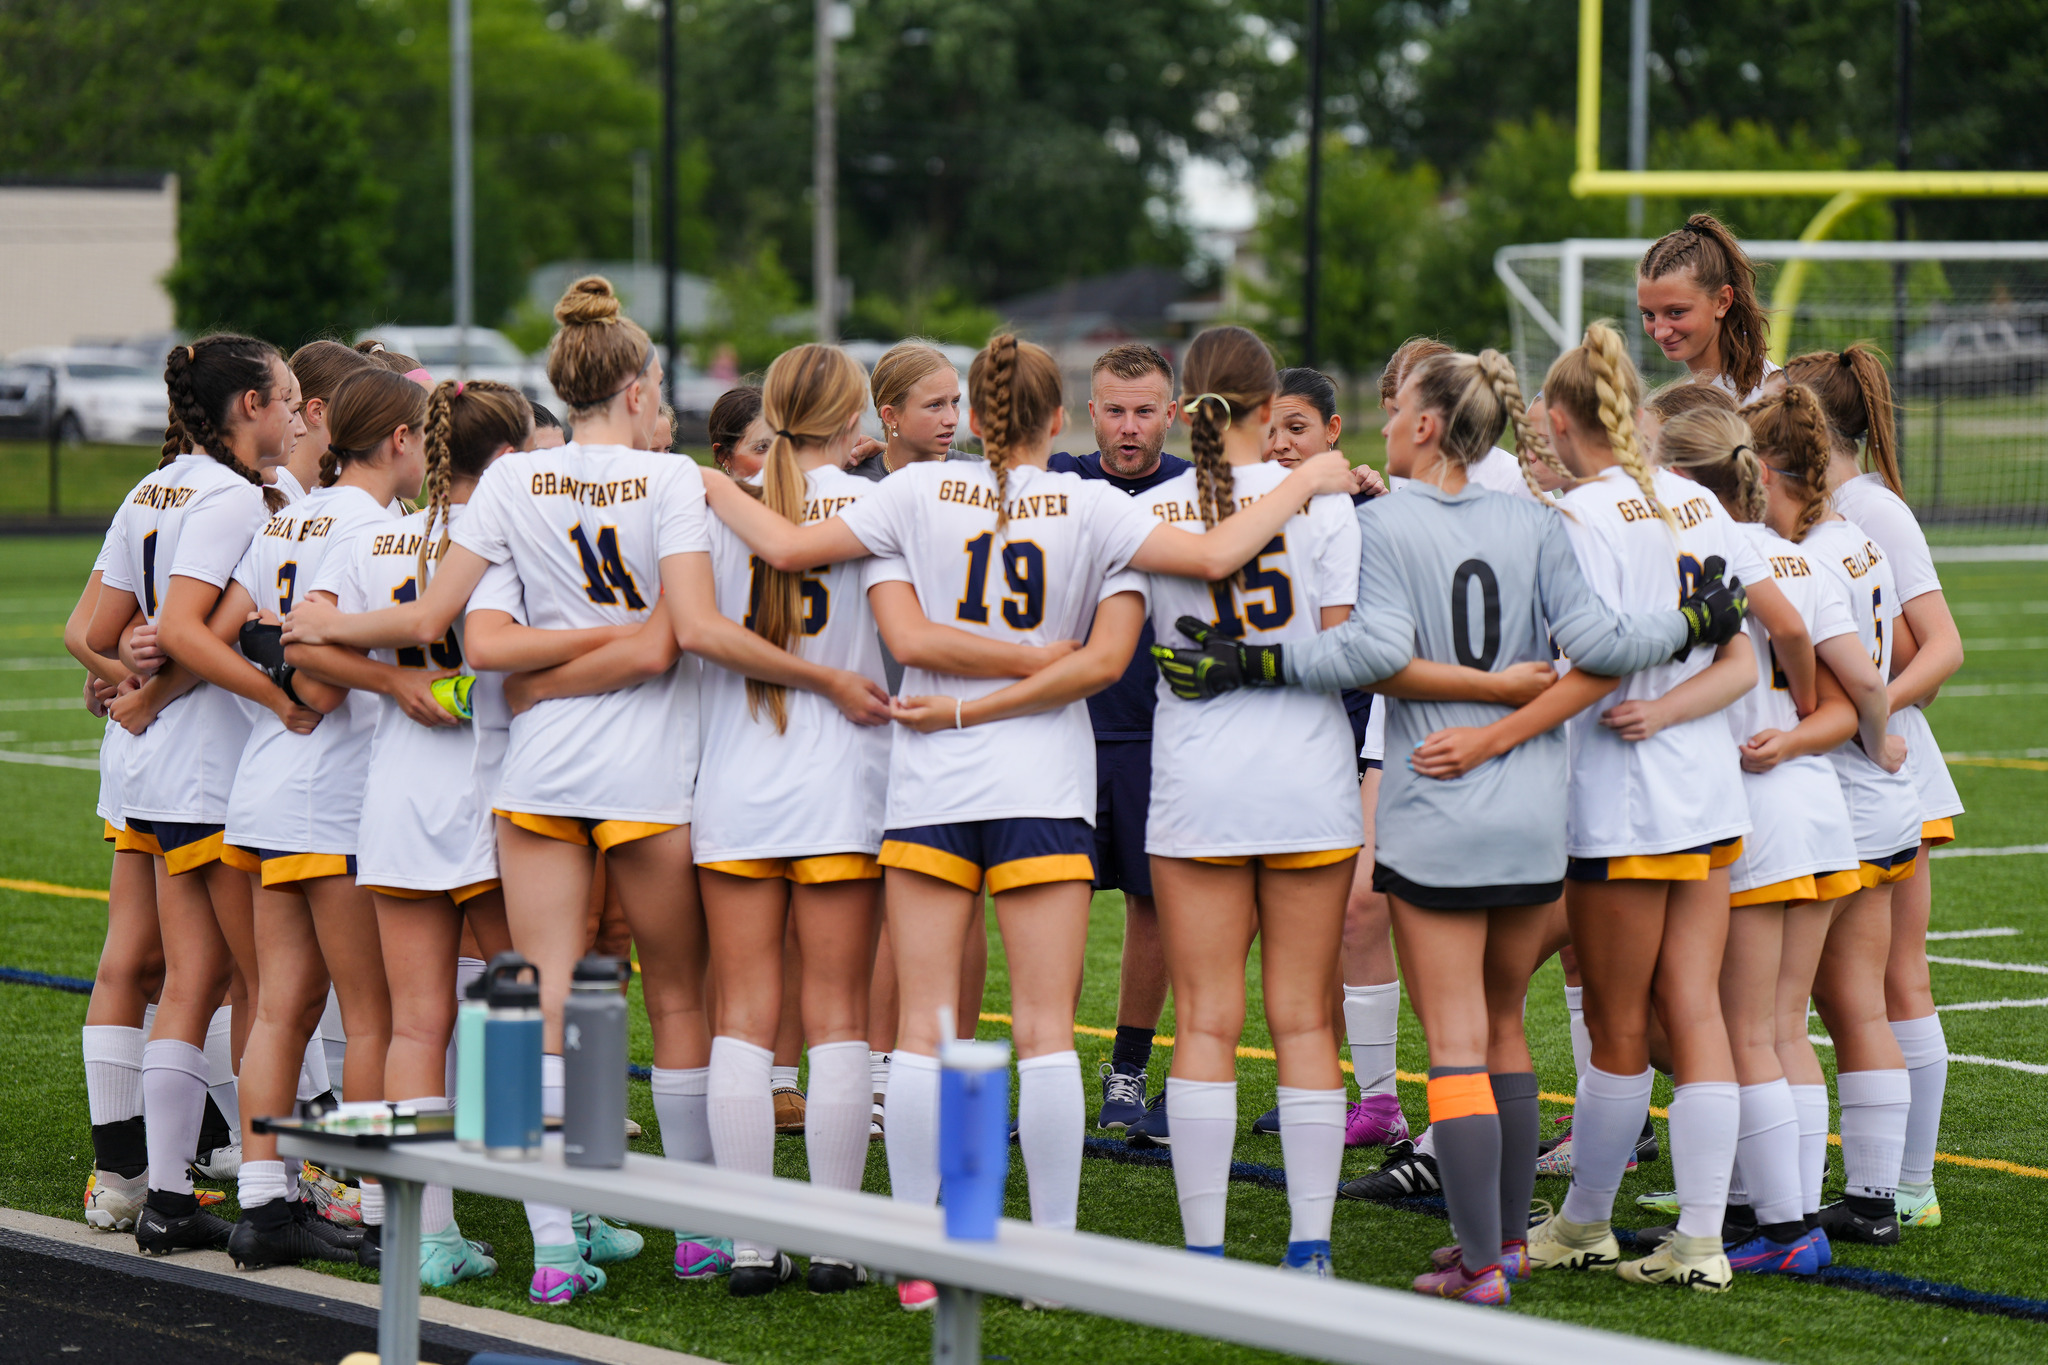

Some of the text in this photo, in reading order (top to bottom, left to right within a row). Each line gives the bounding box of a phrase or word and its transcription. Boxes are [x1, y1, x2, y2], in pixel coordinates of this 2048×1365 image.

[939, 480, 1001, 512] GRAN
[372, 533, 423, 556] GRAN
[568, 520, 648, 612] 14
[1768, 556, 1812, 579] AVEN
[955, 529, 1046, 632] 19
[1451, 558, 1502, 673] 0
